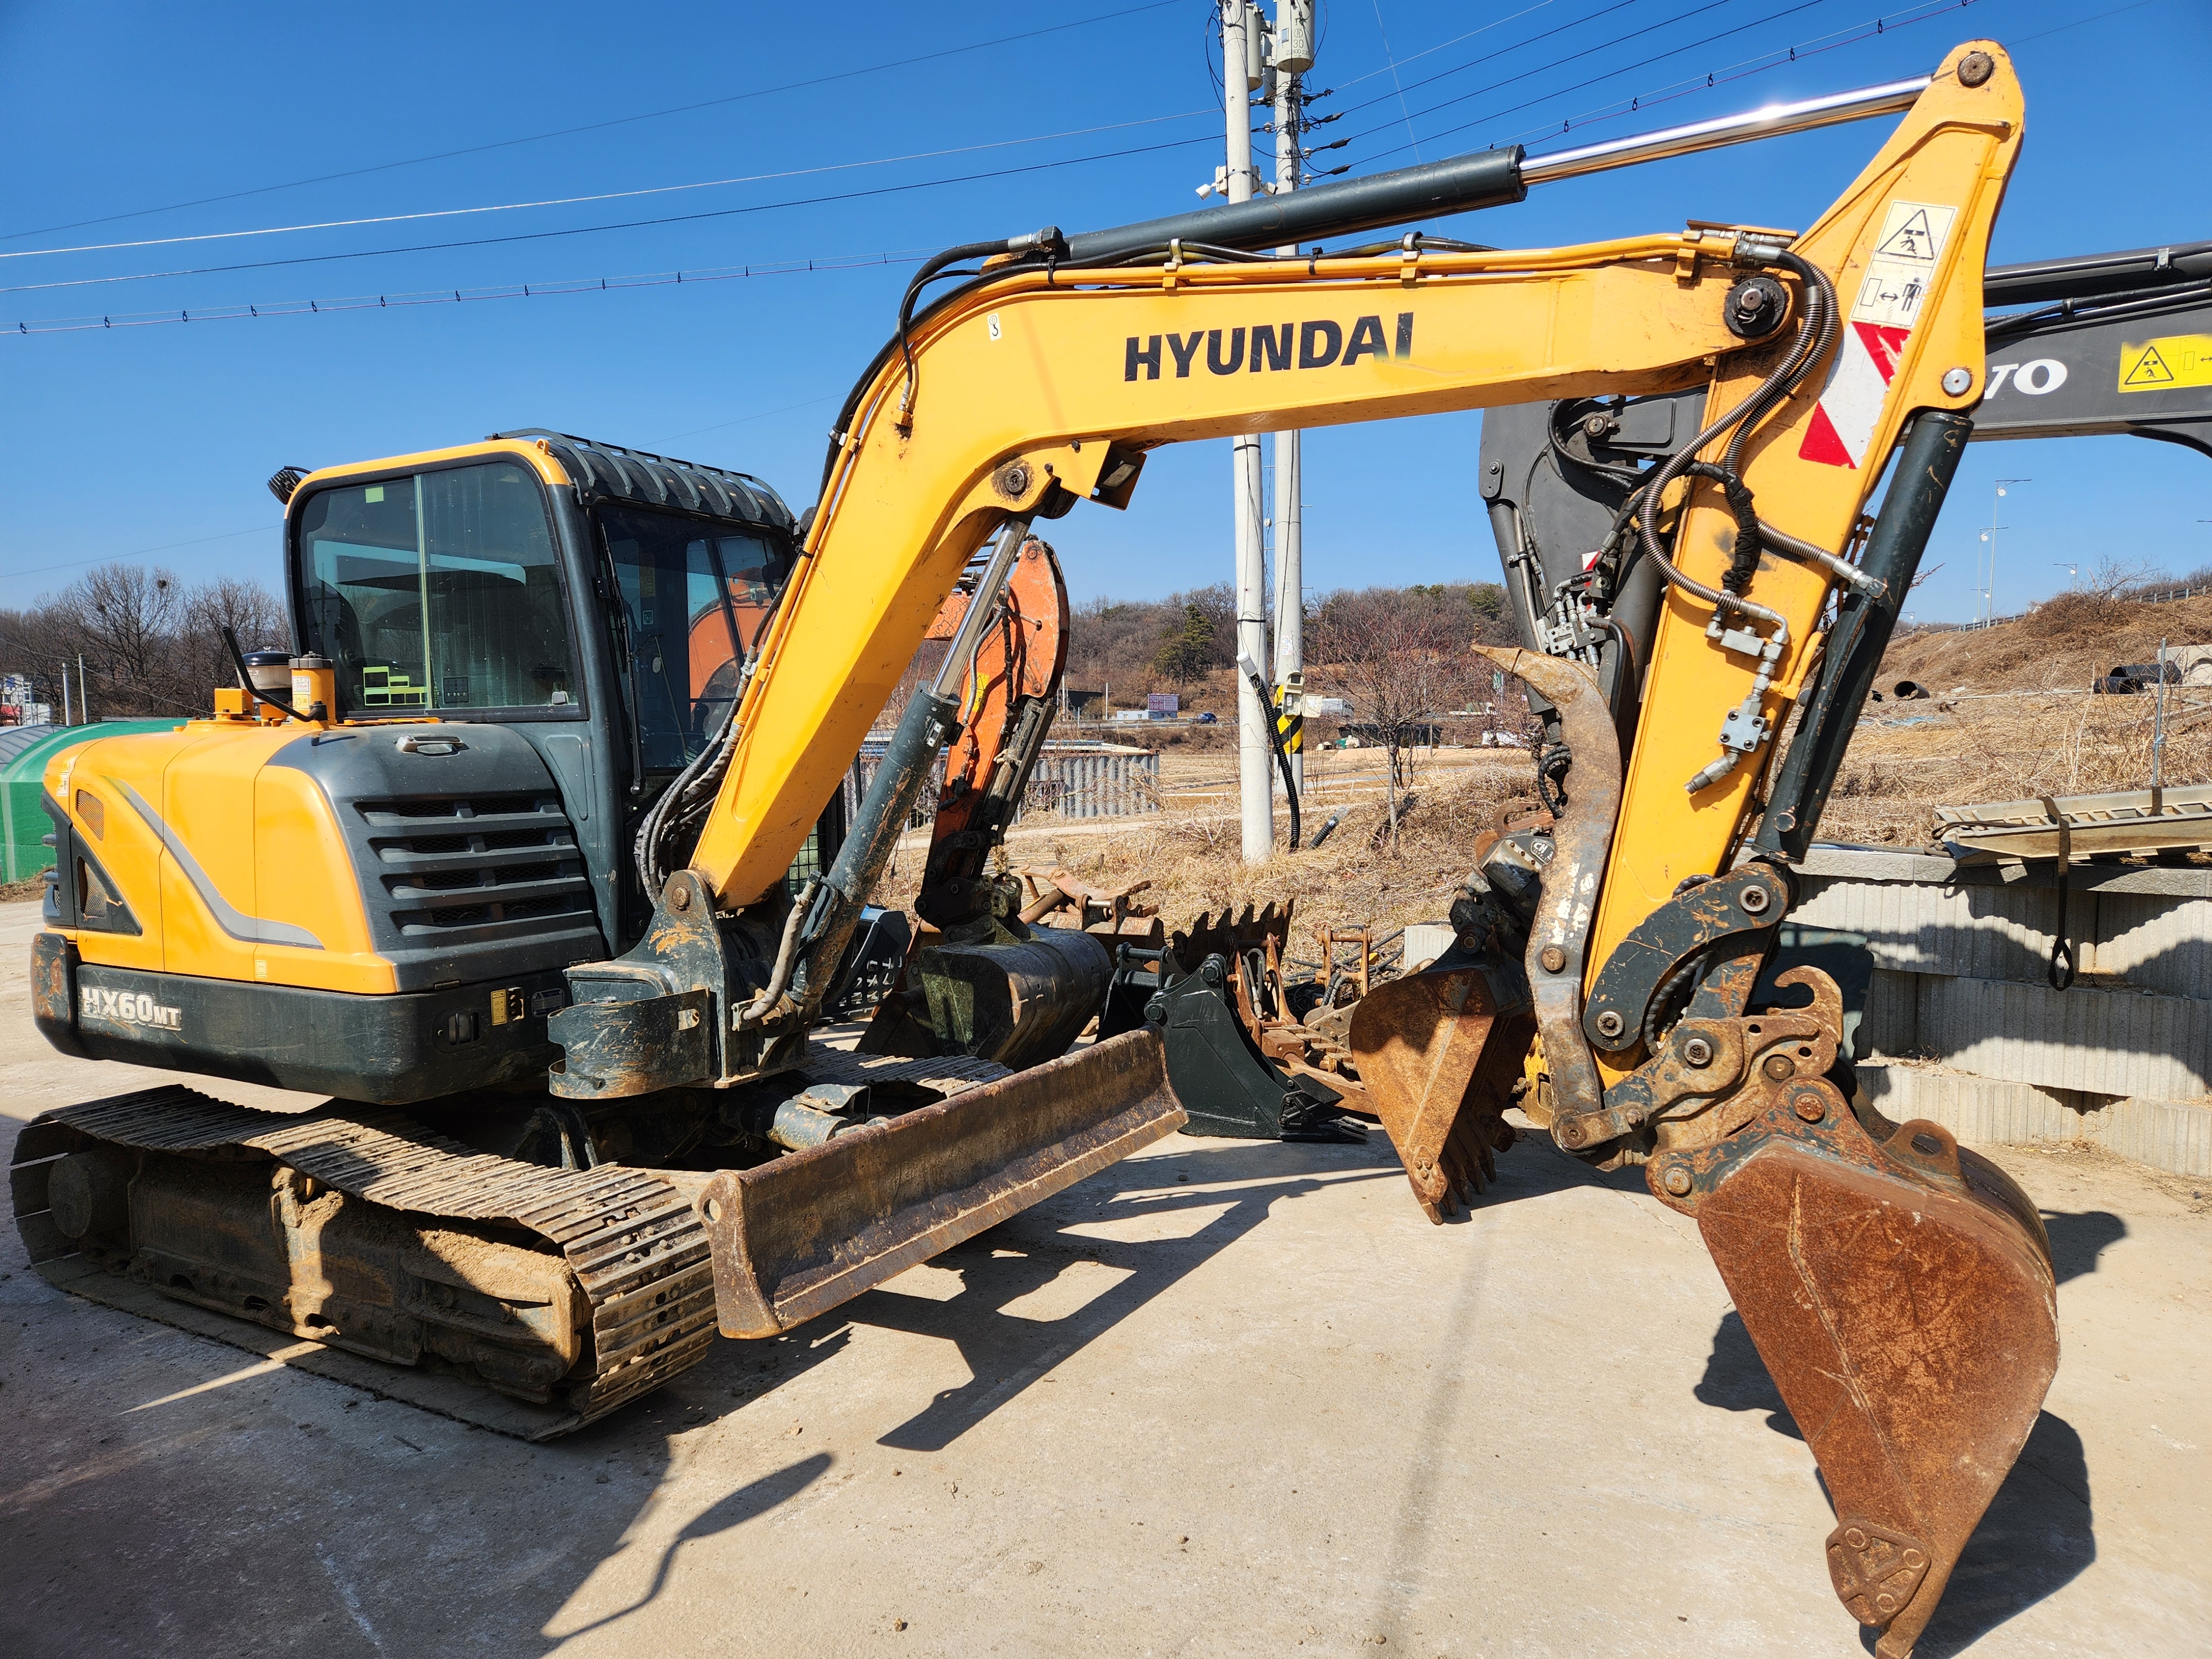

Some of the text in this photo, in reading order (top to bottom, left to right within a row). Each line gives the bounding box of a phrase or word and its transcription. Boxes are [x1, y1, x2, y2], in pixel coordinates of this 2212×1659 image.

[1293, 39, 1304, 48] 30
[1124, 311, 1414, 382] HYUNDAI
[81, 987, 181, 1029] HX60MT
